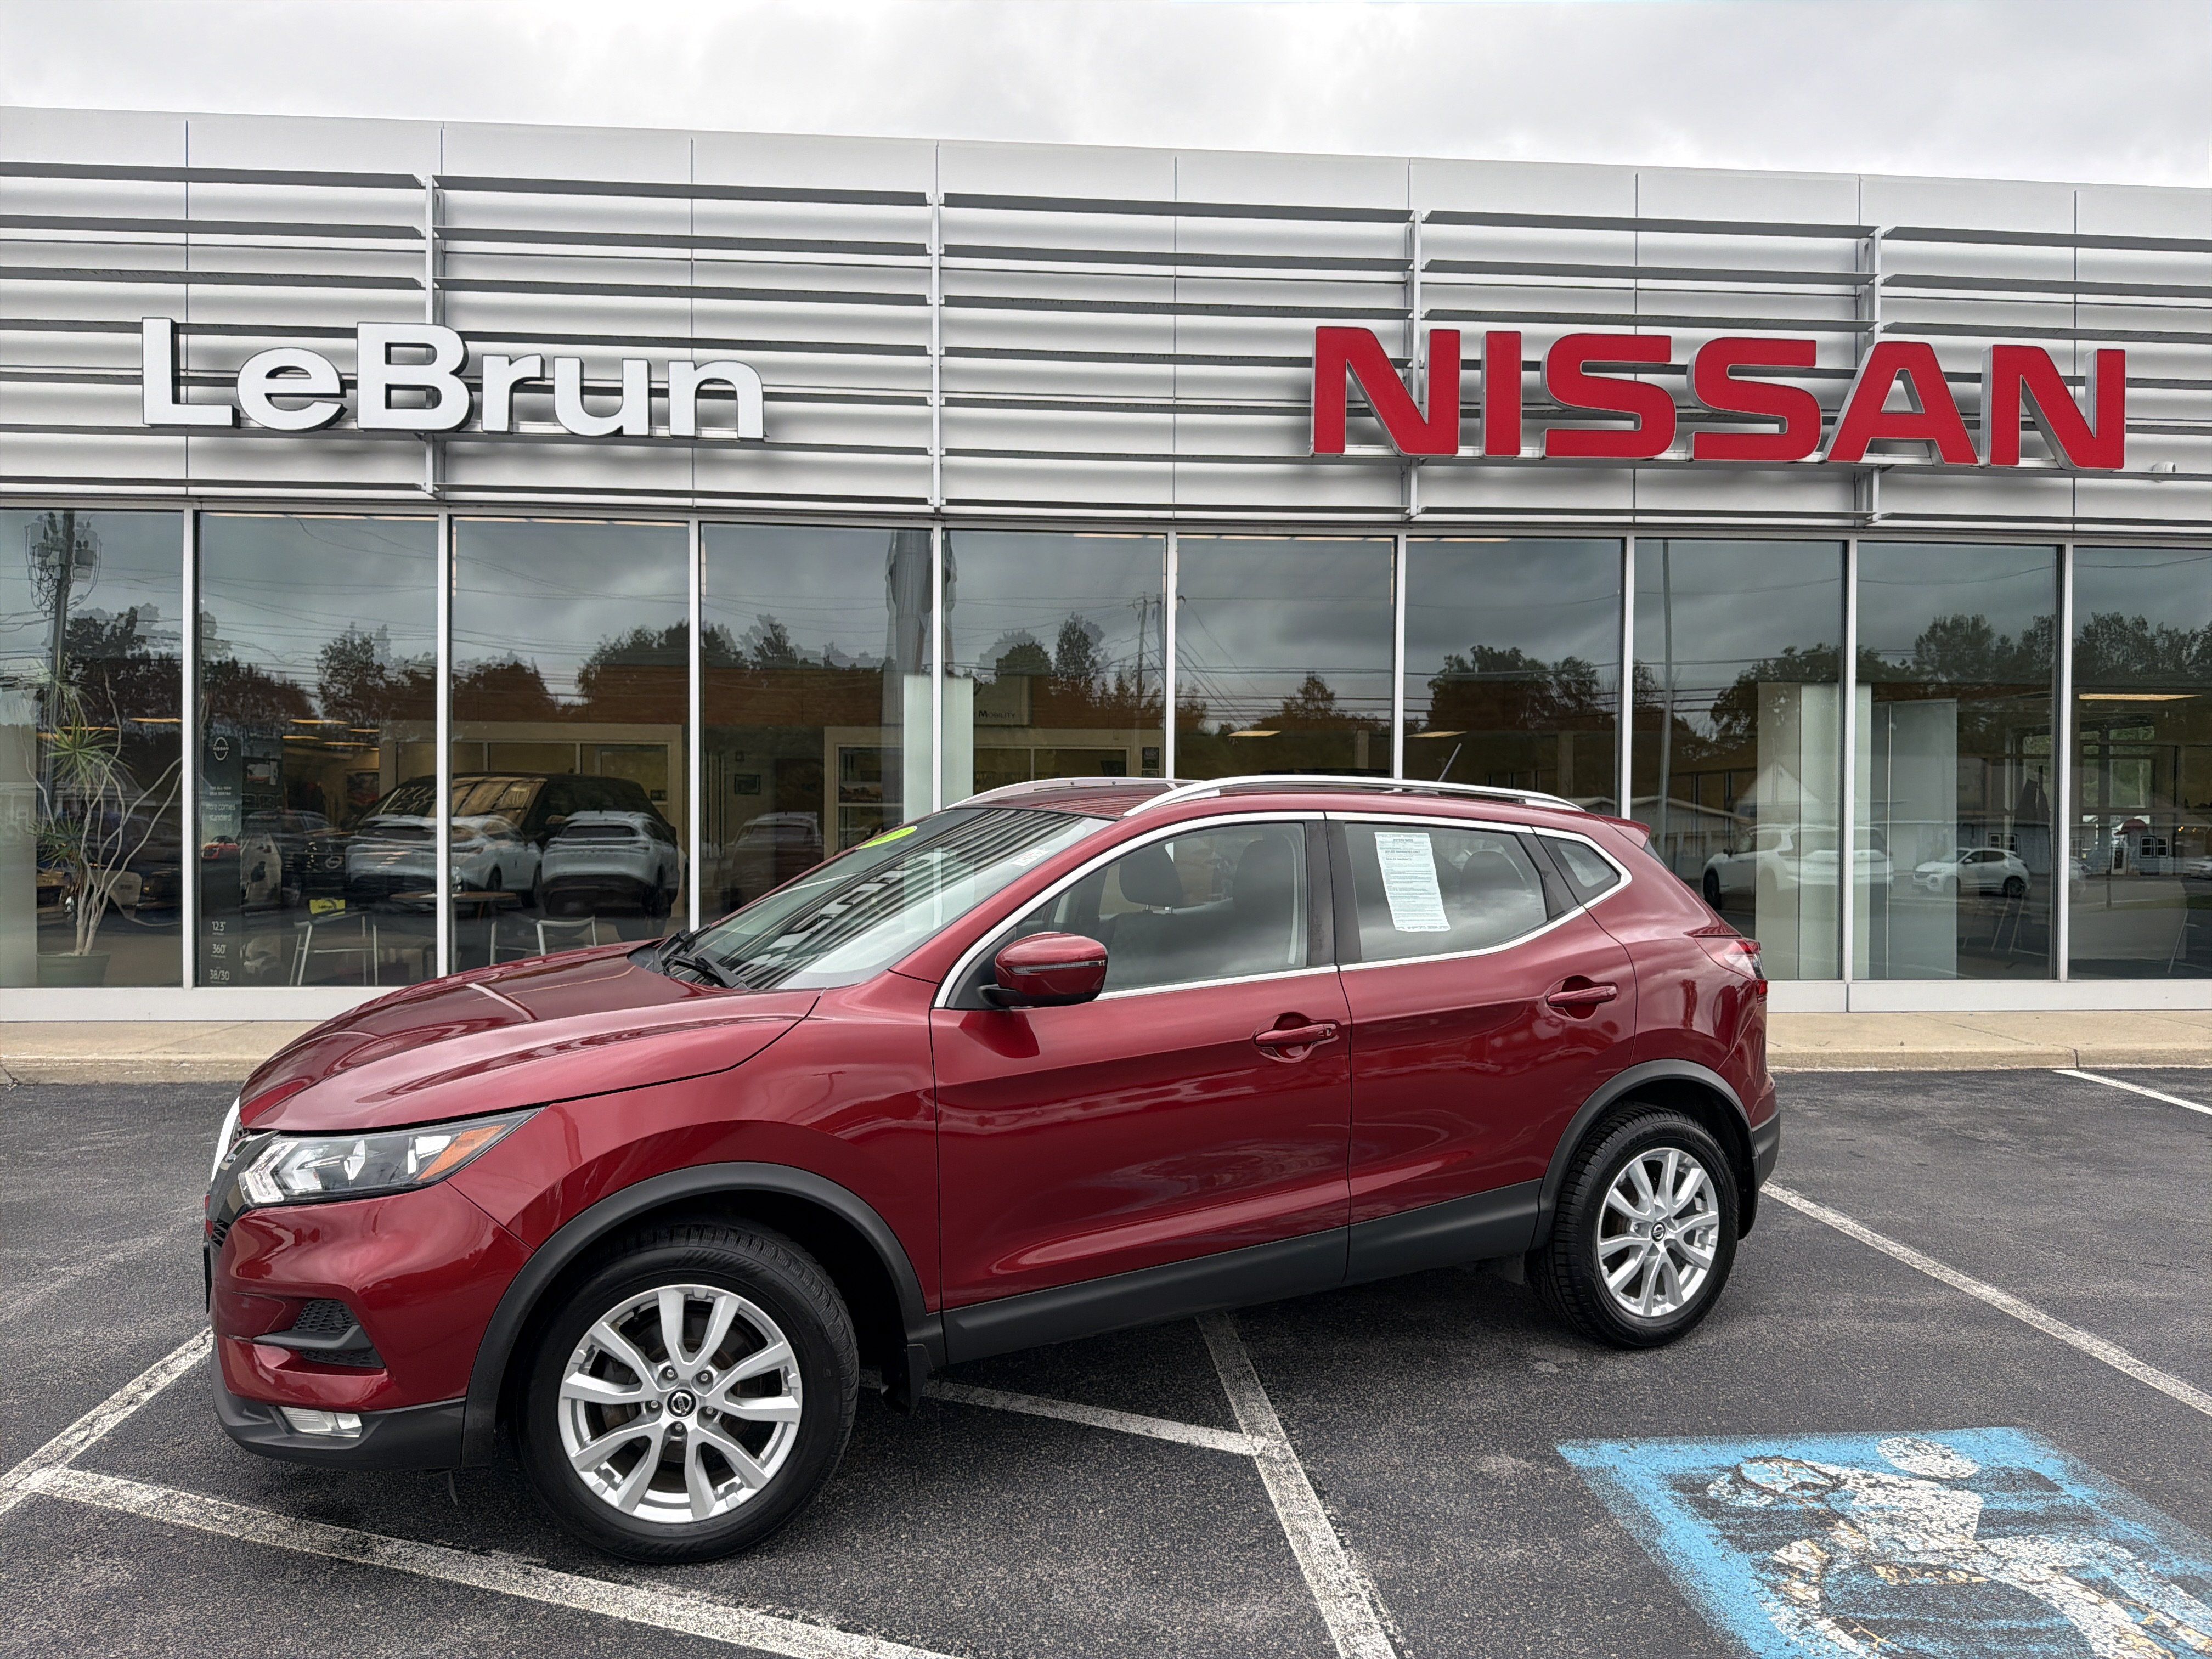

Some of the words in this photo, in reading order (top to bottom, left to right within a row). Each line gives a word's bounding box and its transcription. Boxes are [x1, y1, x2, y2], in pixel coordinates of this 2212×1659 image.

[142, 317, 765, 439] LeBrun
[1312, 326, 2126, 470] NISSAN
[210, 969, 230, 981] 38/30
